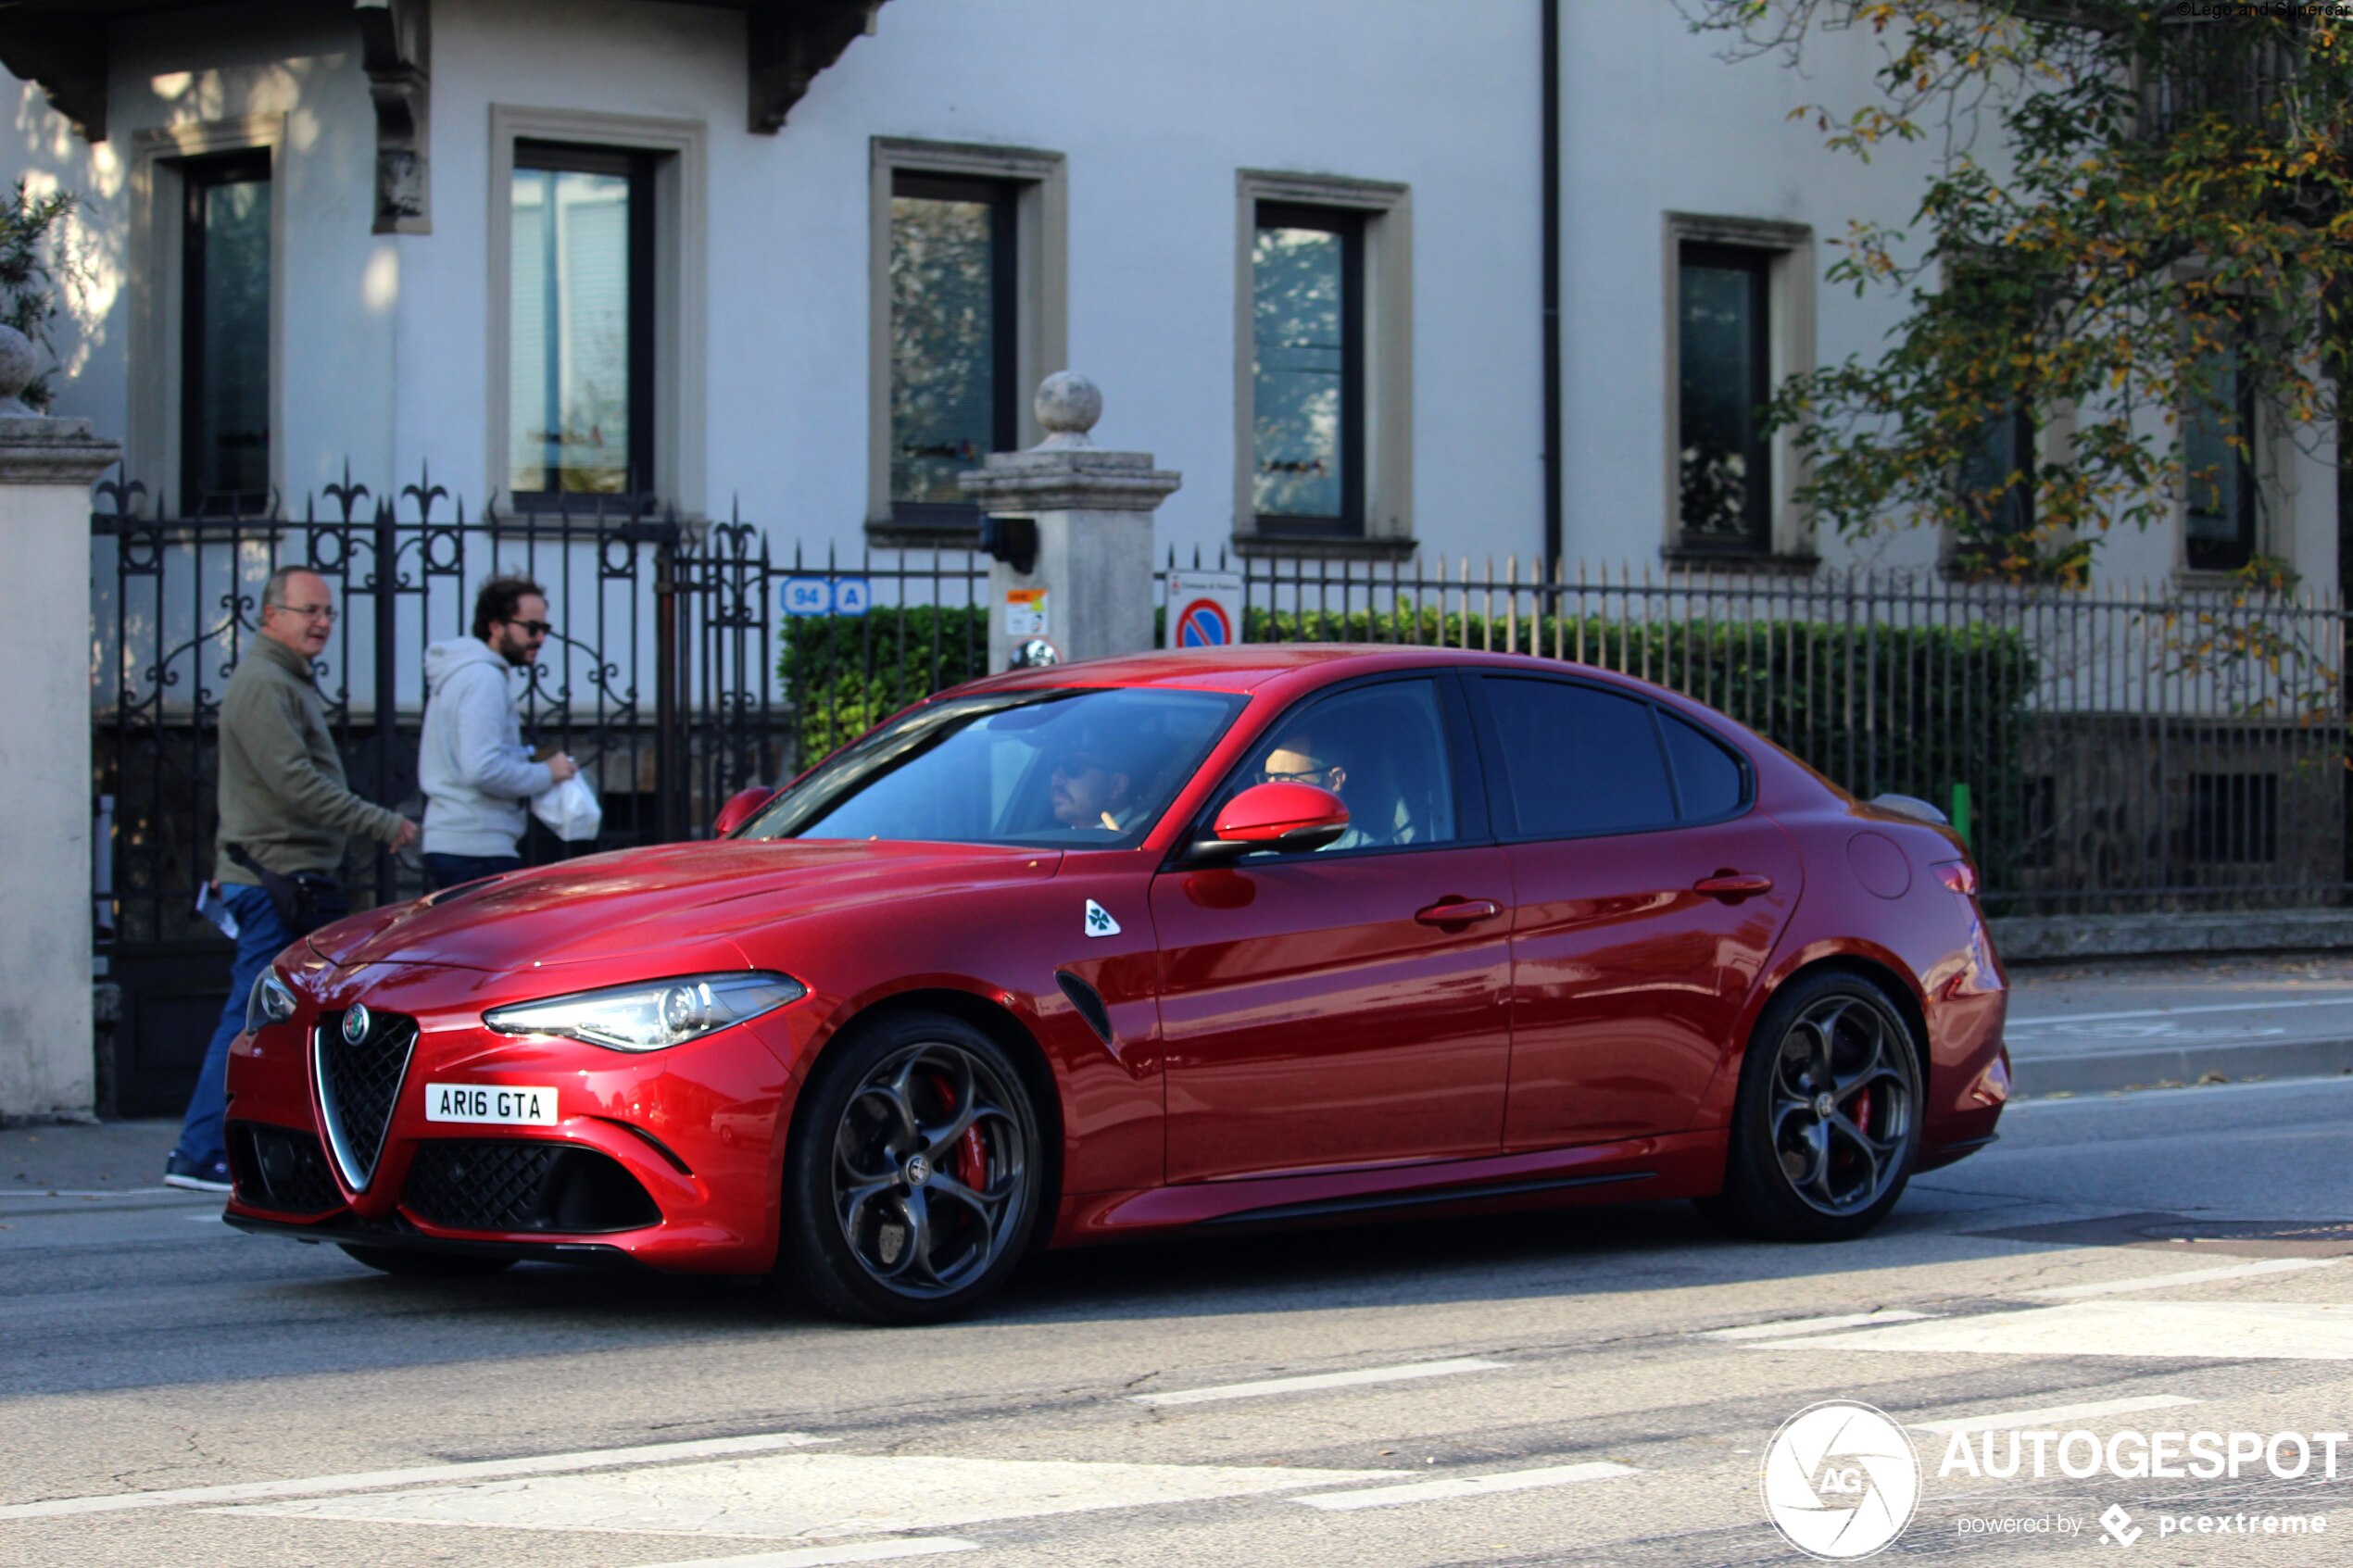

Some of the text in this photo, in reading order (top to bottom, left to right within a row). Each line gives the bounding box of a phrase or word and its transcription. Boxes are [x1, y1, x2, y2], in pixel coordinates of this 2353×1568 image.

[794, 587, 859, 606] 94 A
[440, 1089, 541, 1119] AR16 GTA
